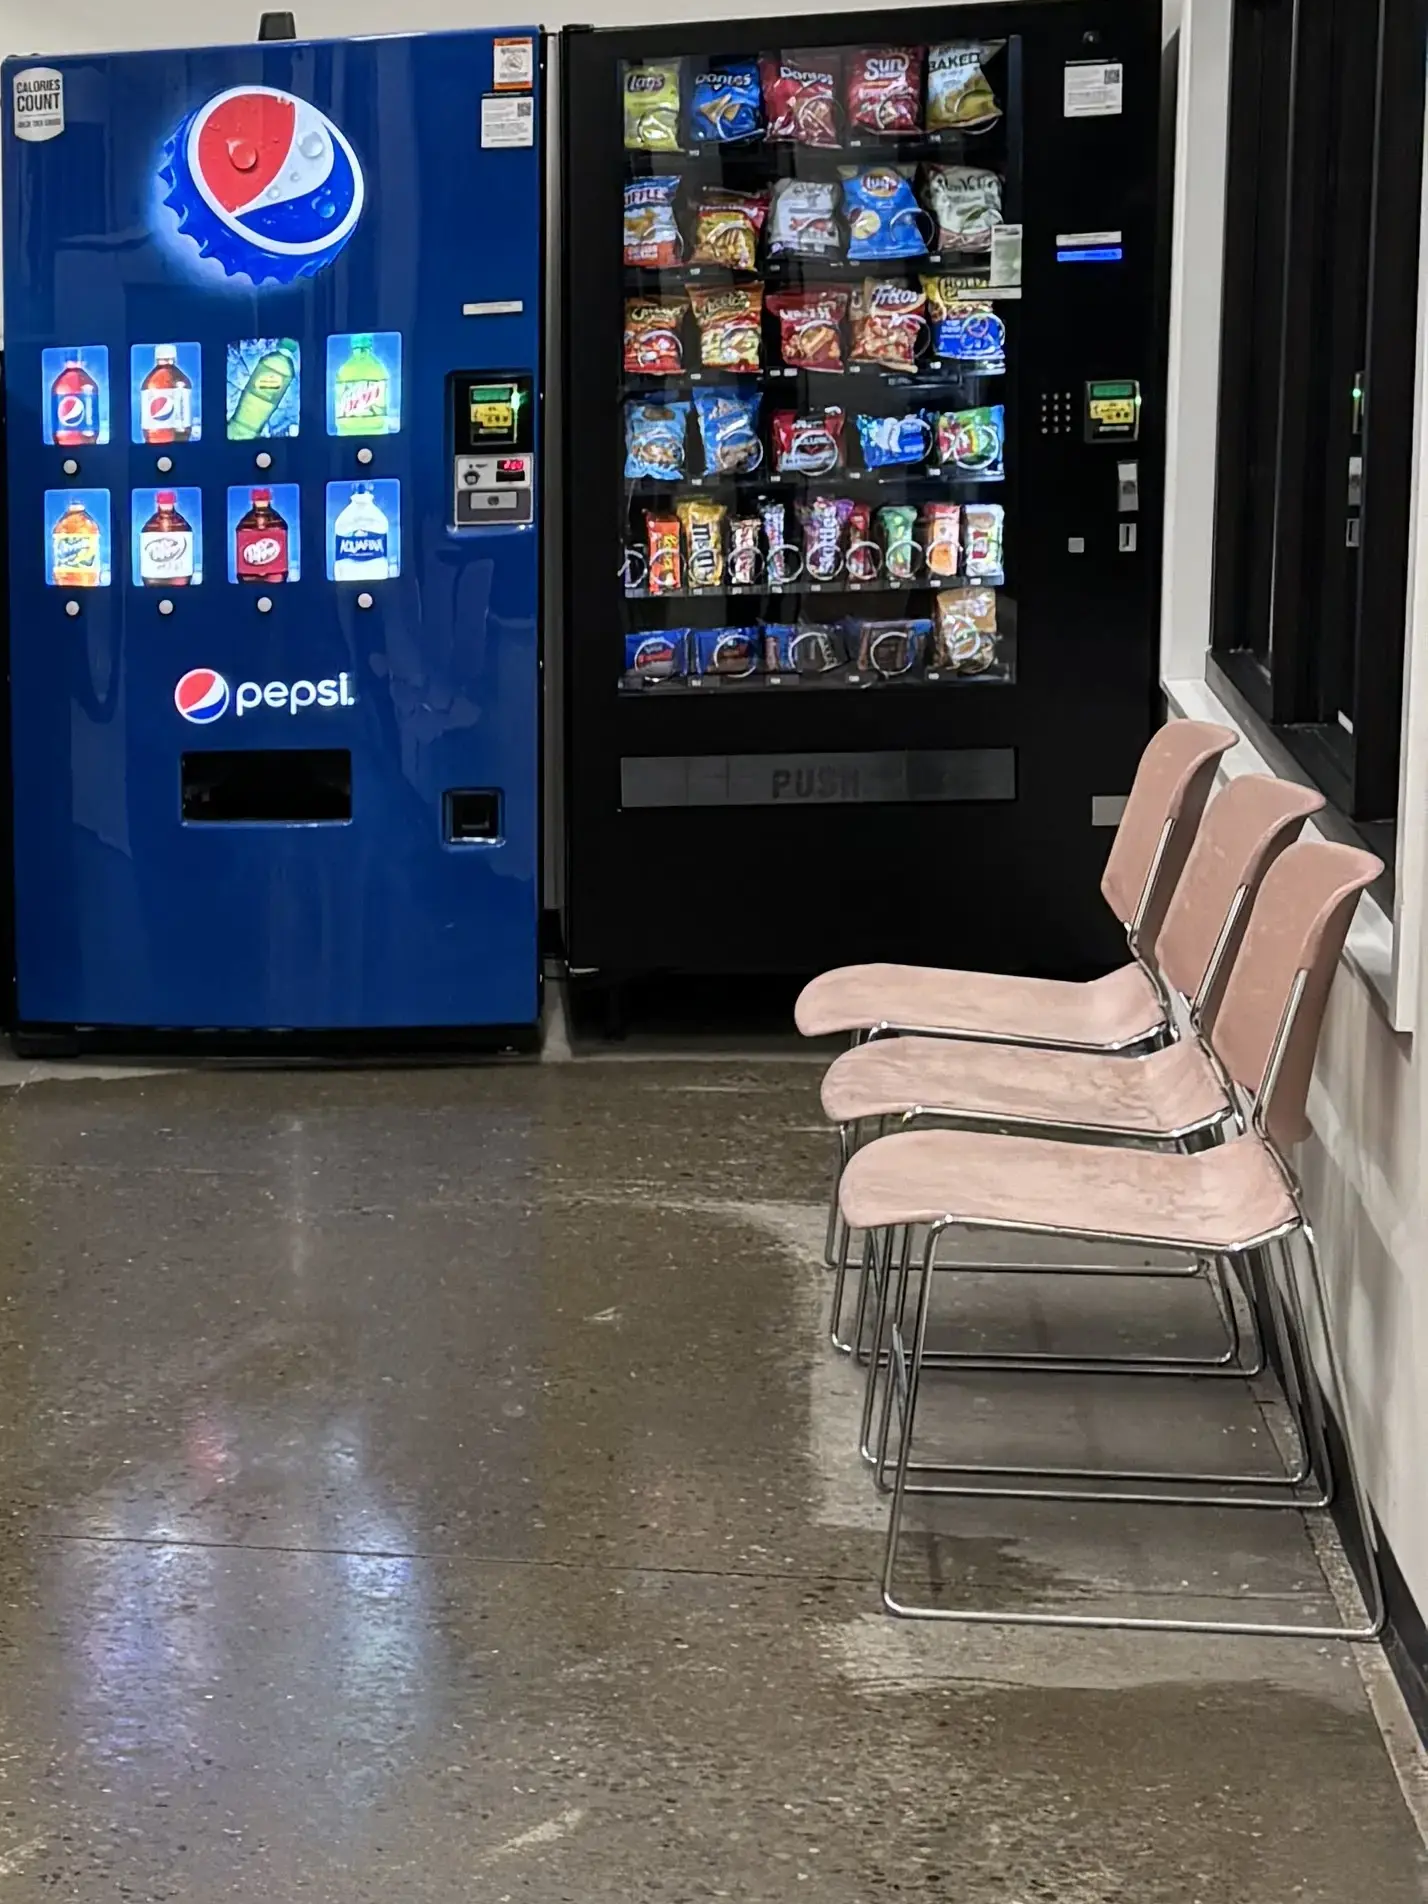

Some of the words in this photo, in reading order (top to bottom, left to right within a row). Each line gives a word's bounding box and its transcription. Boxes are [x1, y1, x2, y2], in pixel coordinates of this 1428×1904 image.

[863, 52, 910, 81] Sun
[16, 78, 61, 94] CALORIES
[16, 92, 61, 113] COUNT
[235, 671, 350, 717] pepsi
